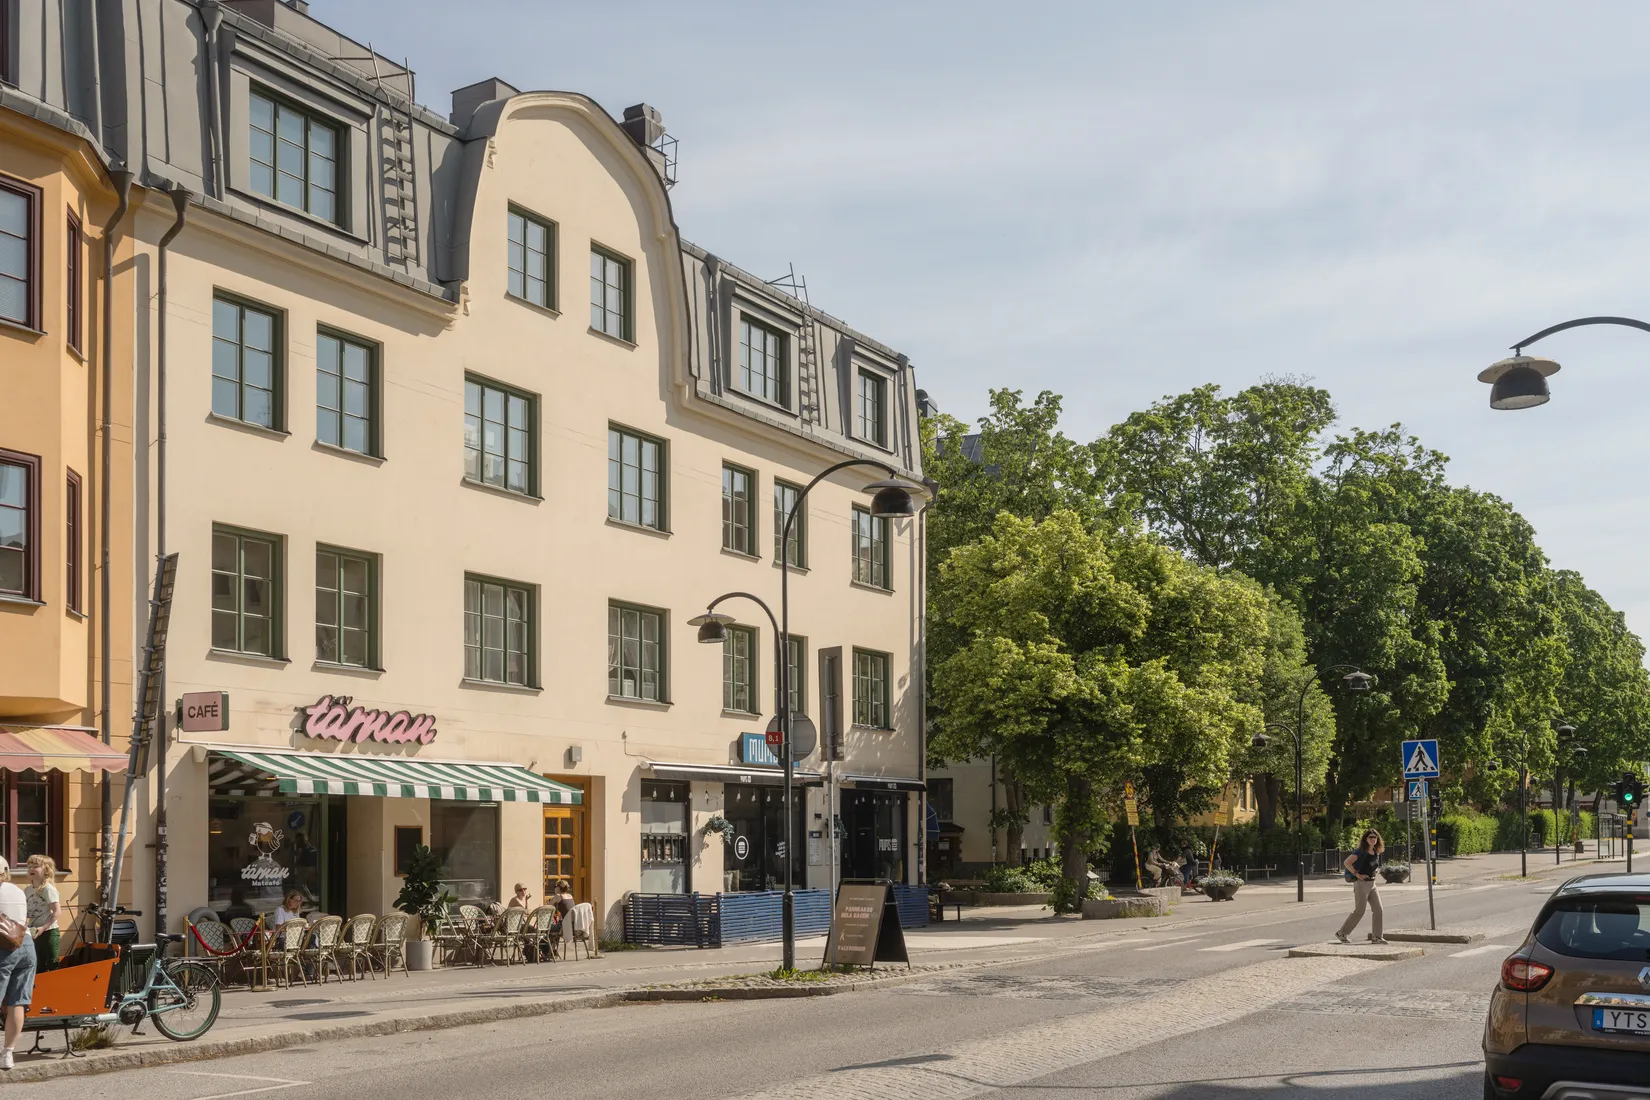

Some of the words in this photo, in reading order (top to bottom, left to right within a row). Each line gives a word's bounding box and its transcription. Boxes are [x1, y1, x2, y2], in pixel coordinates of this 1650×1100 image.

[187, 701, 218, 719] CAFÉ
[303, 694, 437, 744] tärnan
[749, 738, 779, 764] MUM
[241, 863, 290, 880] tärnan
[1611, 1011, 1647, 1028] YTS
